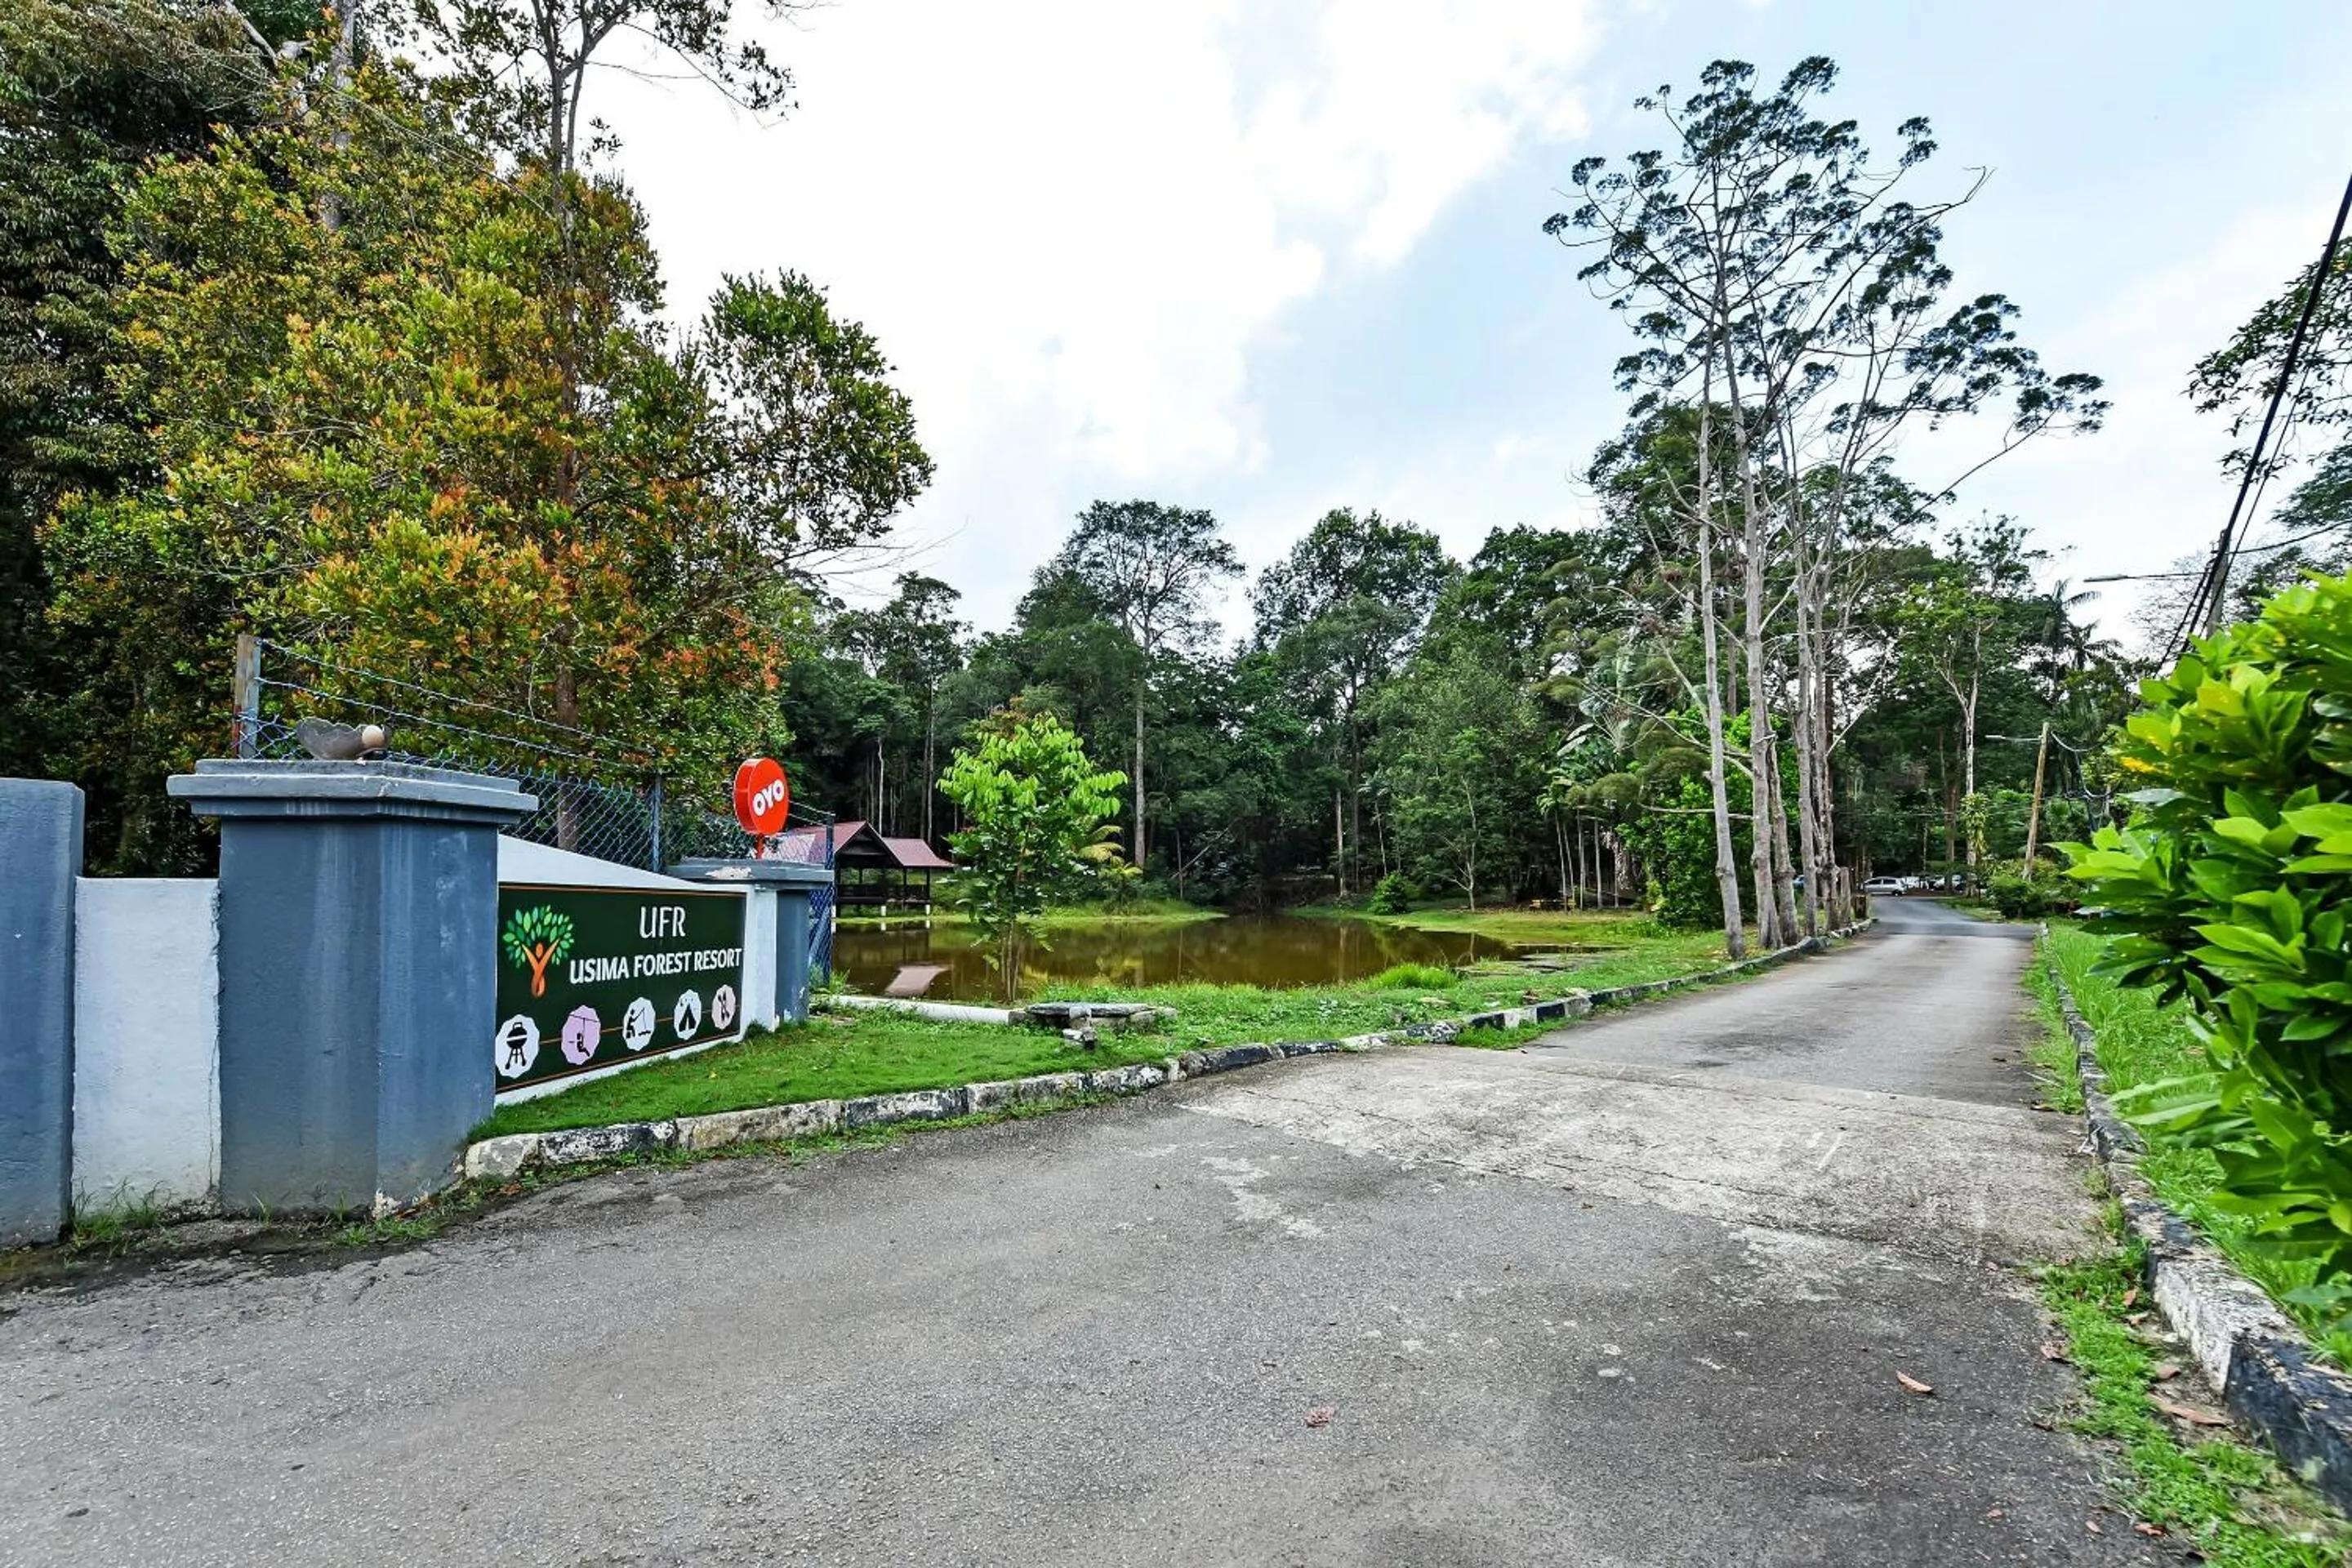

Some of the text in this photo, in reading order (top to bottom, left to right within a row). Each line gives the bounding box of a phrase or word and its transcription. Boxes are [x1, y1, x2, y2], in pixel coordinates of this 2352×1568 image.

[752, 779, 785, 817] OYO
[639, 906, 686, 938] UFR
[570, 948, 742, 983] USIMA FOREST RESORT
